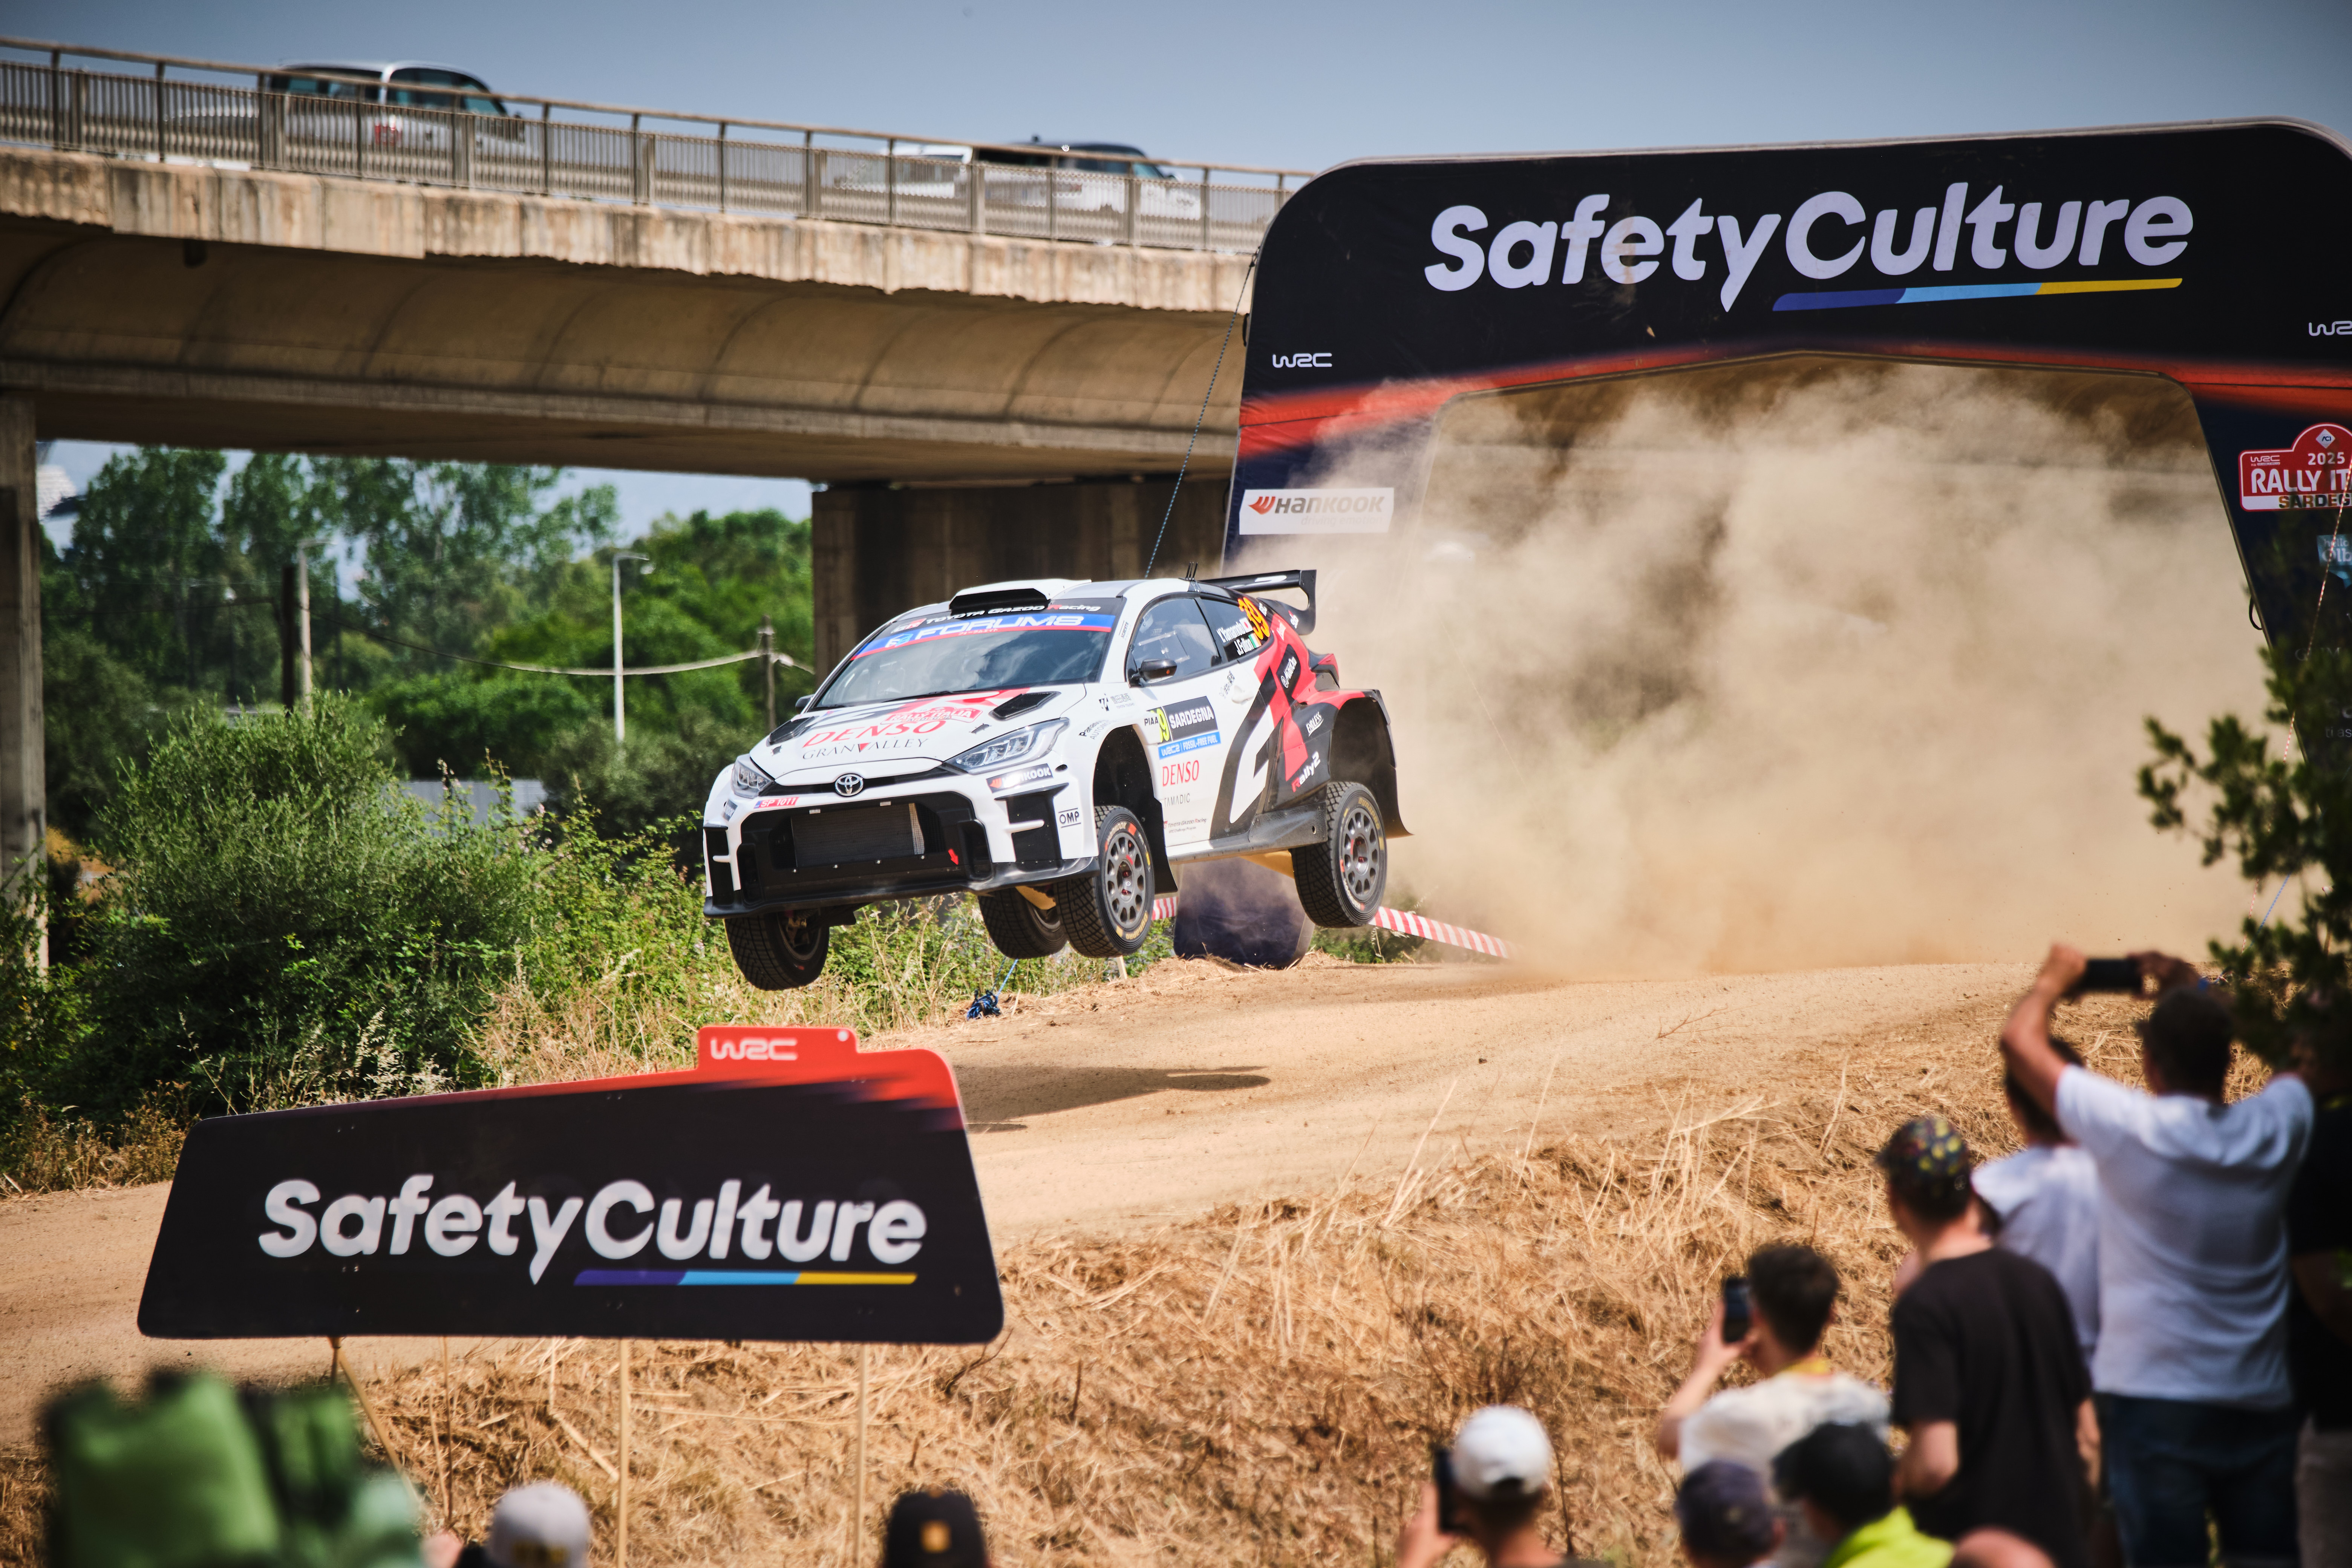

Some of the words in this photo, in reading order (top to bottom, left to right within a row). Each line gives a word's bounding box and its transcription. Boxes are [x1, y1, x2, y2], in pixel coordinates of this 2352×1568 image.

[1424, 182, 2193, 312] SafetyCulture
[2309, 320, 2352, 336] WR
[1272, 353, 1332, 368] WRC
[2308, 452, 2345, 465] 2025
[2251, 468, 2322, 493] RALLY
[2278, 493, 2352, 508] SARDEG
[1301, 516, 1335, 526] driving
[2322, 548, 2352, 562] Olb
[926, 610, 985, 624] TOYOTA
[988, 605, 1045, 614] GAZOO
[1238, 597, 1270, 640] 39
[914, 615, 1084, 640] FORUM8
[1144, 717, 1159, 726] PIAA
[1169, 706, 1214, 729] SARDEGNA
[1306, 712, 1322, 733] ENDLESS
[802, 720, 946, 748] DENSO
[1161, 743, 1180, 756] WRC2
[1183, 737, 1207, 750] FOSSIL-FREE
[1208, 735, 1218, 743] FUEL
[1162, 760, 1199, 787] DENSO
[1291, 751, 1320, 792] Rally2
[776, 797, 796, 805] 1011
[1164, 793, 1190, 807] TAMADIC
[1060, 811, 1080, 824] OMP
[710, 1037, 798, 1060] WRC
[258, 1174, 927, 1285] SafetyCulture
